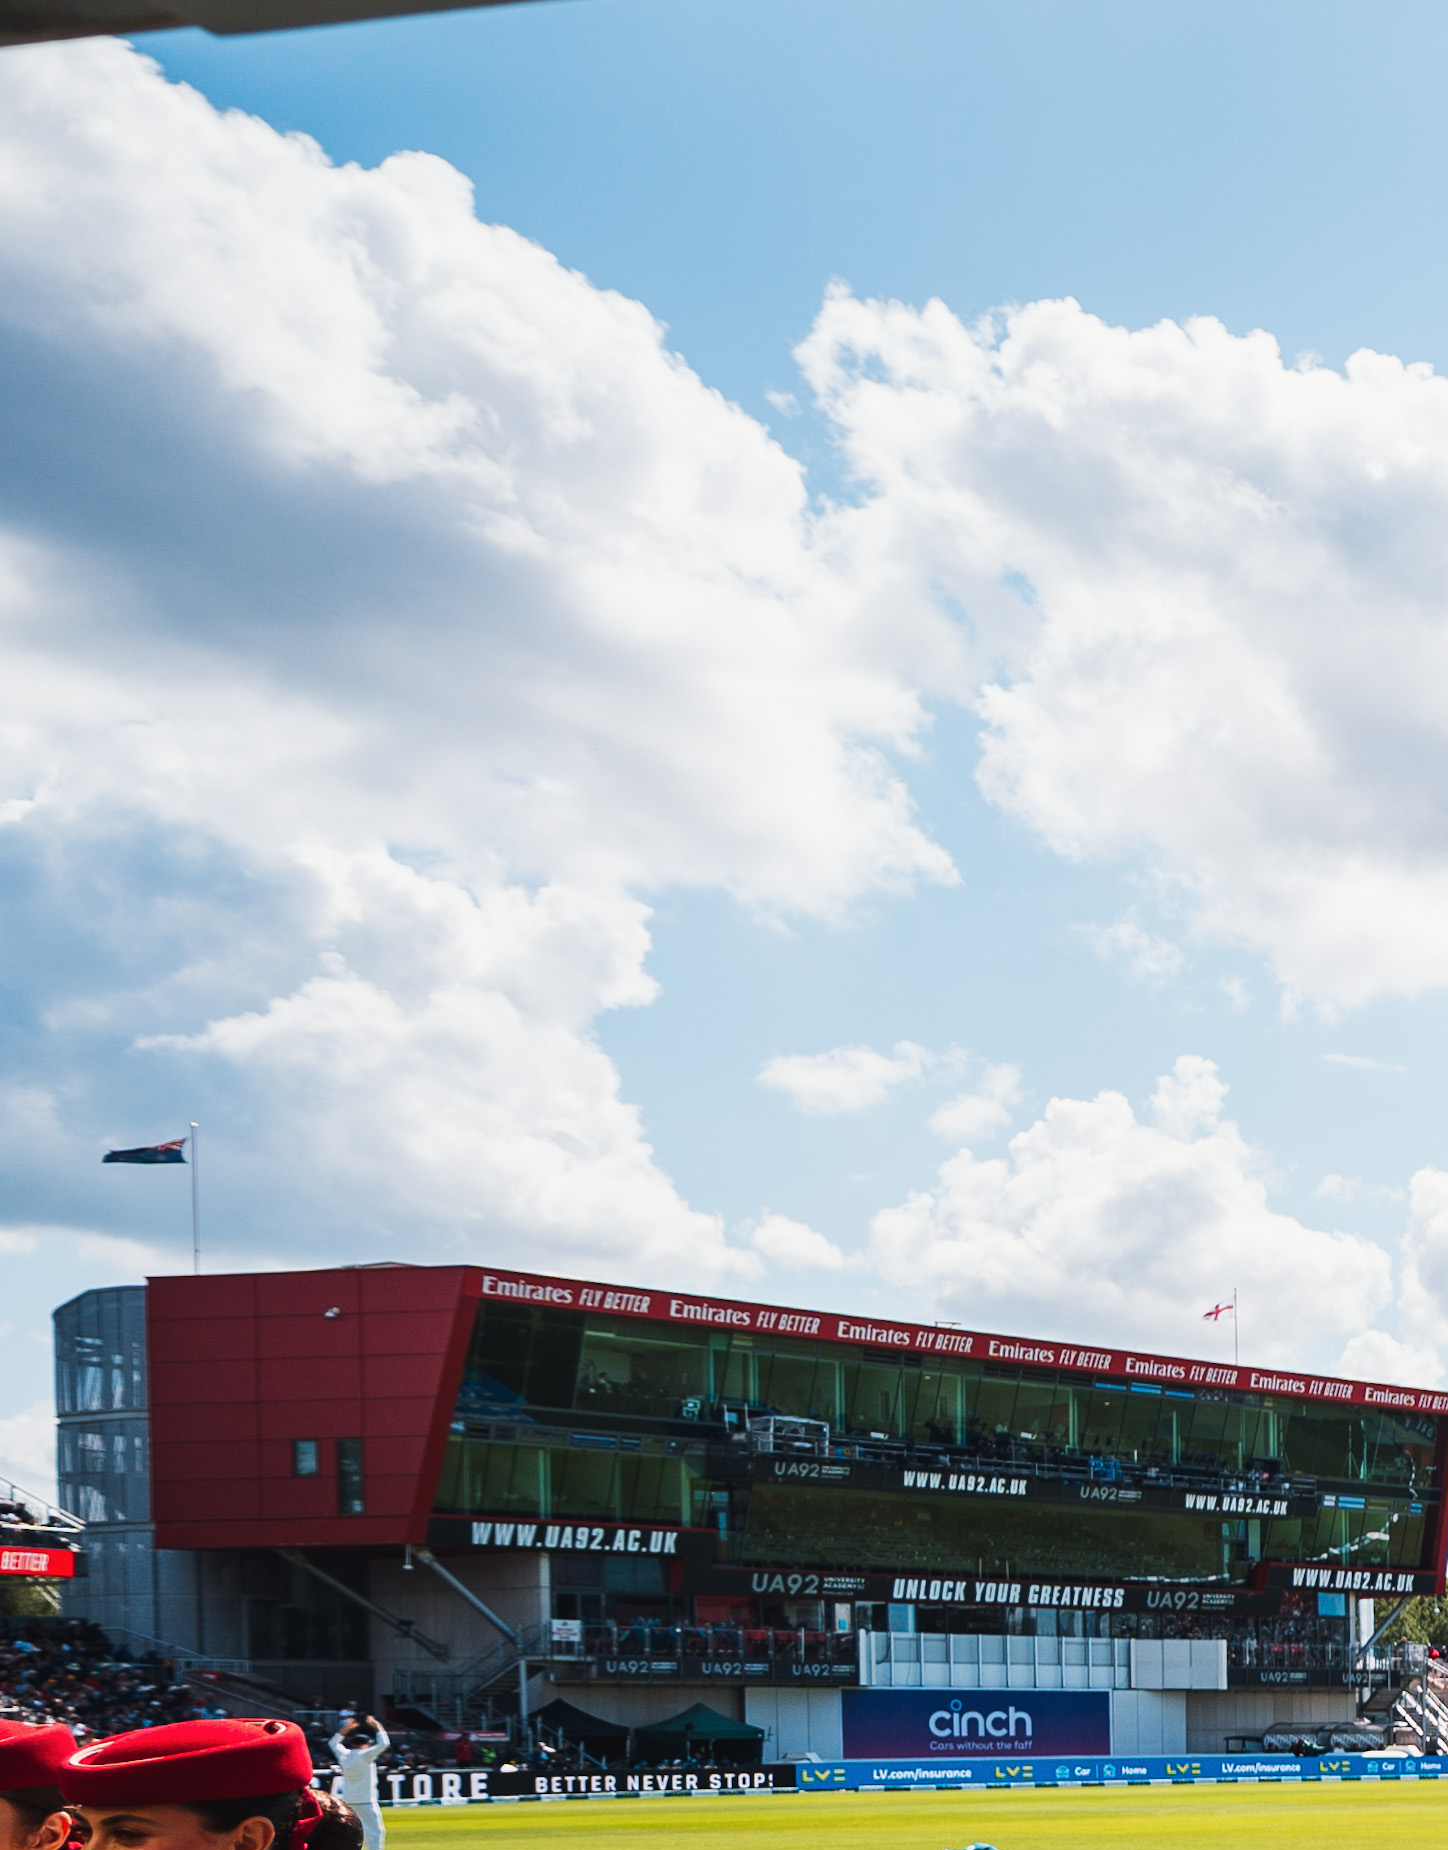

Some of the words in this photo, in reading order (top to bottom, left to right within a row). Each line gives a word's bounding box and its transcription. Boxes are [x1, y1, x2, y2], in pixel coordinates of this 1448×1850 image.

[482, 1275, 574, 1305] Emirates
[578, 1288, 601, 1308] FLY
[602, 1291, 652, 1315] BETTER
[669, 1299, 751, 1326] Emirates
[755, 1309, 776, 1330] FLY
[779, 1313, 821, 1335] BETTER
[837, 1320, 911, 1347] Emirates
[915, 1331, 934, 1349] FLY
[935, 1334, 974, 1354] BETTER
[988, 1340, 1055, 1364] Emirates
[1058, 1349, 1075, 1367] FLY
[1077, 1352, 1113, 1371] BETTER
[1125, 1356, 1187, 1379] Emirates
[1189, 1364, 1205, 1382] FLY
[1206, 1367, 1239, 1386] BETTER
[1250, 1372, 1306, 1394] Emirates
[1308, 1379, 1323, 1396] FLY
[1324, 1382, 1354, 1400] BETTER
[1364, 1386, 1416, 1407] Emirates
[1418, 1393, 1432, 1409] FLY
[774, 1461, 820, 1479] UA92
[903, 1470, 1028, 1496] WWW.UA92.AC.UK
[1080, 1486, 1118, 1502] UA92
[471, 1521, 678, 1554] WWW.UA92.AC.UK
[0, 1551, 49, 1572] BETTER
[751, 1573, 820, 1595] UA92
[1292, 1567, 1414, 1592] WWW.UA92.AC.UK
[892, 1578, 967, 1602] UNLOCK
[974, 1582, 1022, 1604] YOUR
[1027, 1585, 1125, 1608] GREATNESS
[1146, 1591, 1200, 1611] UA92
[606, 1660, 649, 1675] UA92
[702, 1662, 743, 1676] UA92
[792, 1663, 831, 1677] UA92
[1260, 1671, 1289, 1684] UA92
[1341, 1672, 1369, 1685] UA92
[928, 1699, 1033, 1738] cinch
[929, 1740, 956, 1751] Cars
[956, 1740, 995, 1751] without
[996, 1740, 1013, 1751] the
[1014, 1740, 1033, 1751] faff
[872, 1767, 973, 1781] LV.com/insurance
[1074, 1766, 1091, 1777] Car
[1121, 1765, 1148, 1776] Home
[1221, 1762, 1302, 1774] LV.com/insurance
[1381, 1761, 1396, 1772] Car
[1419, 1760, 1442, 1771] Home
[534, 1774, 616, 1794] BETTER
[626, 1774, 699, 1792] NEVER
